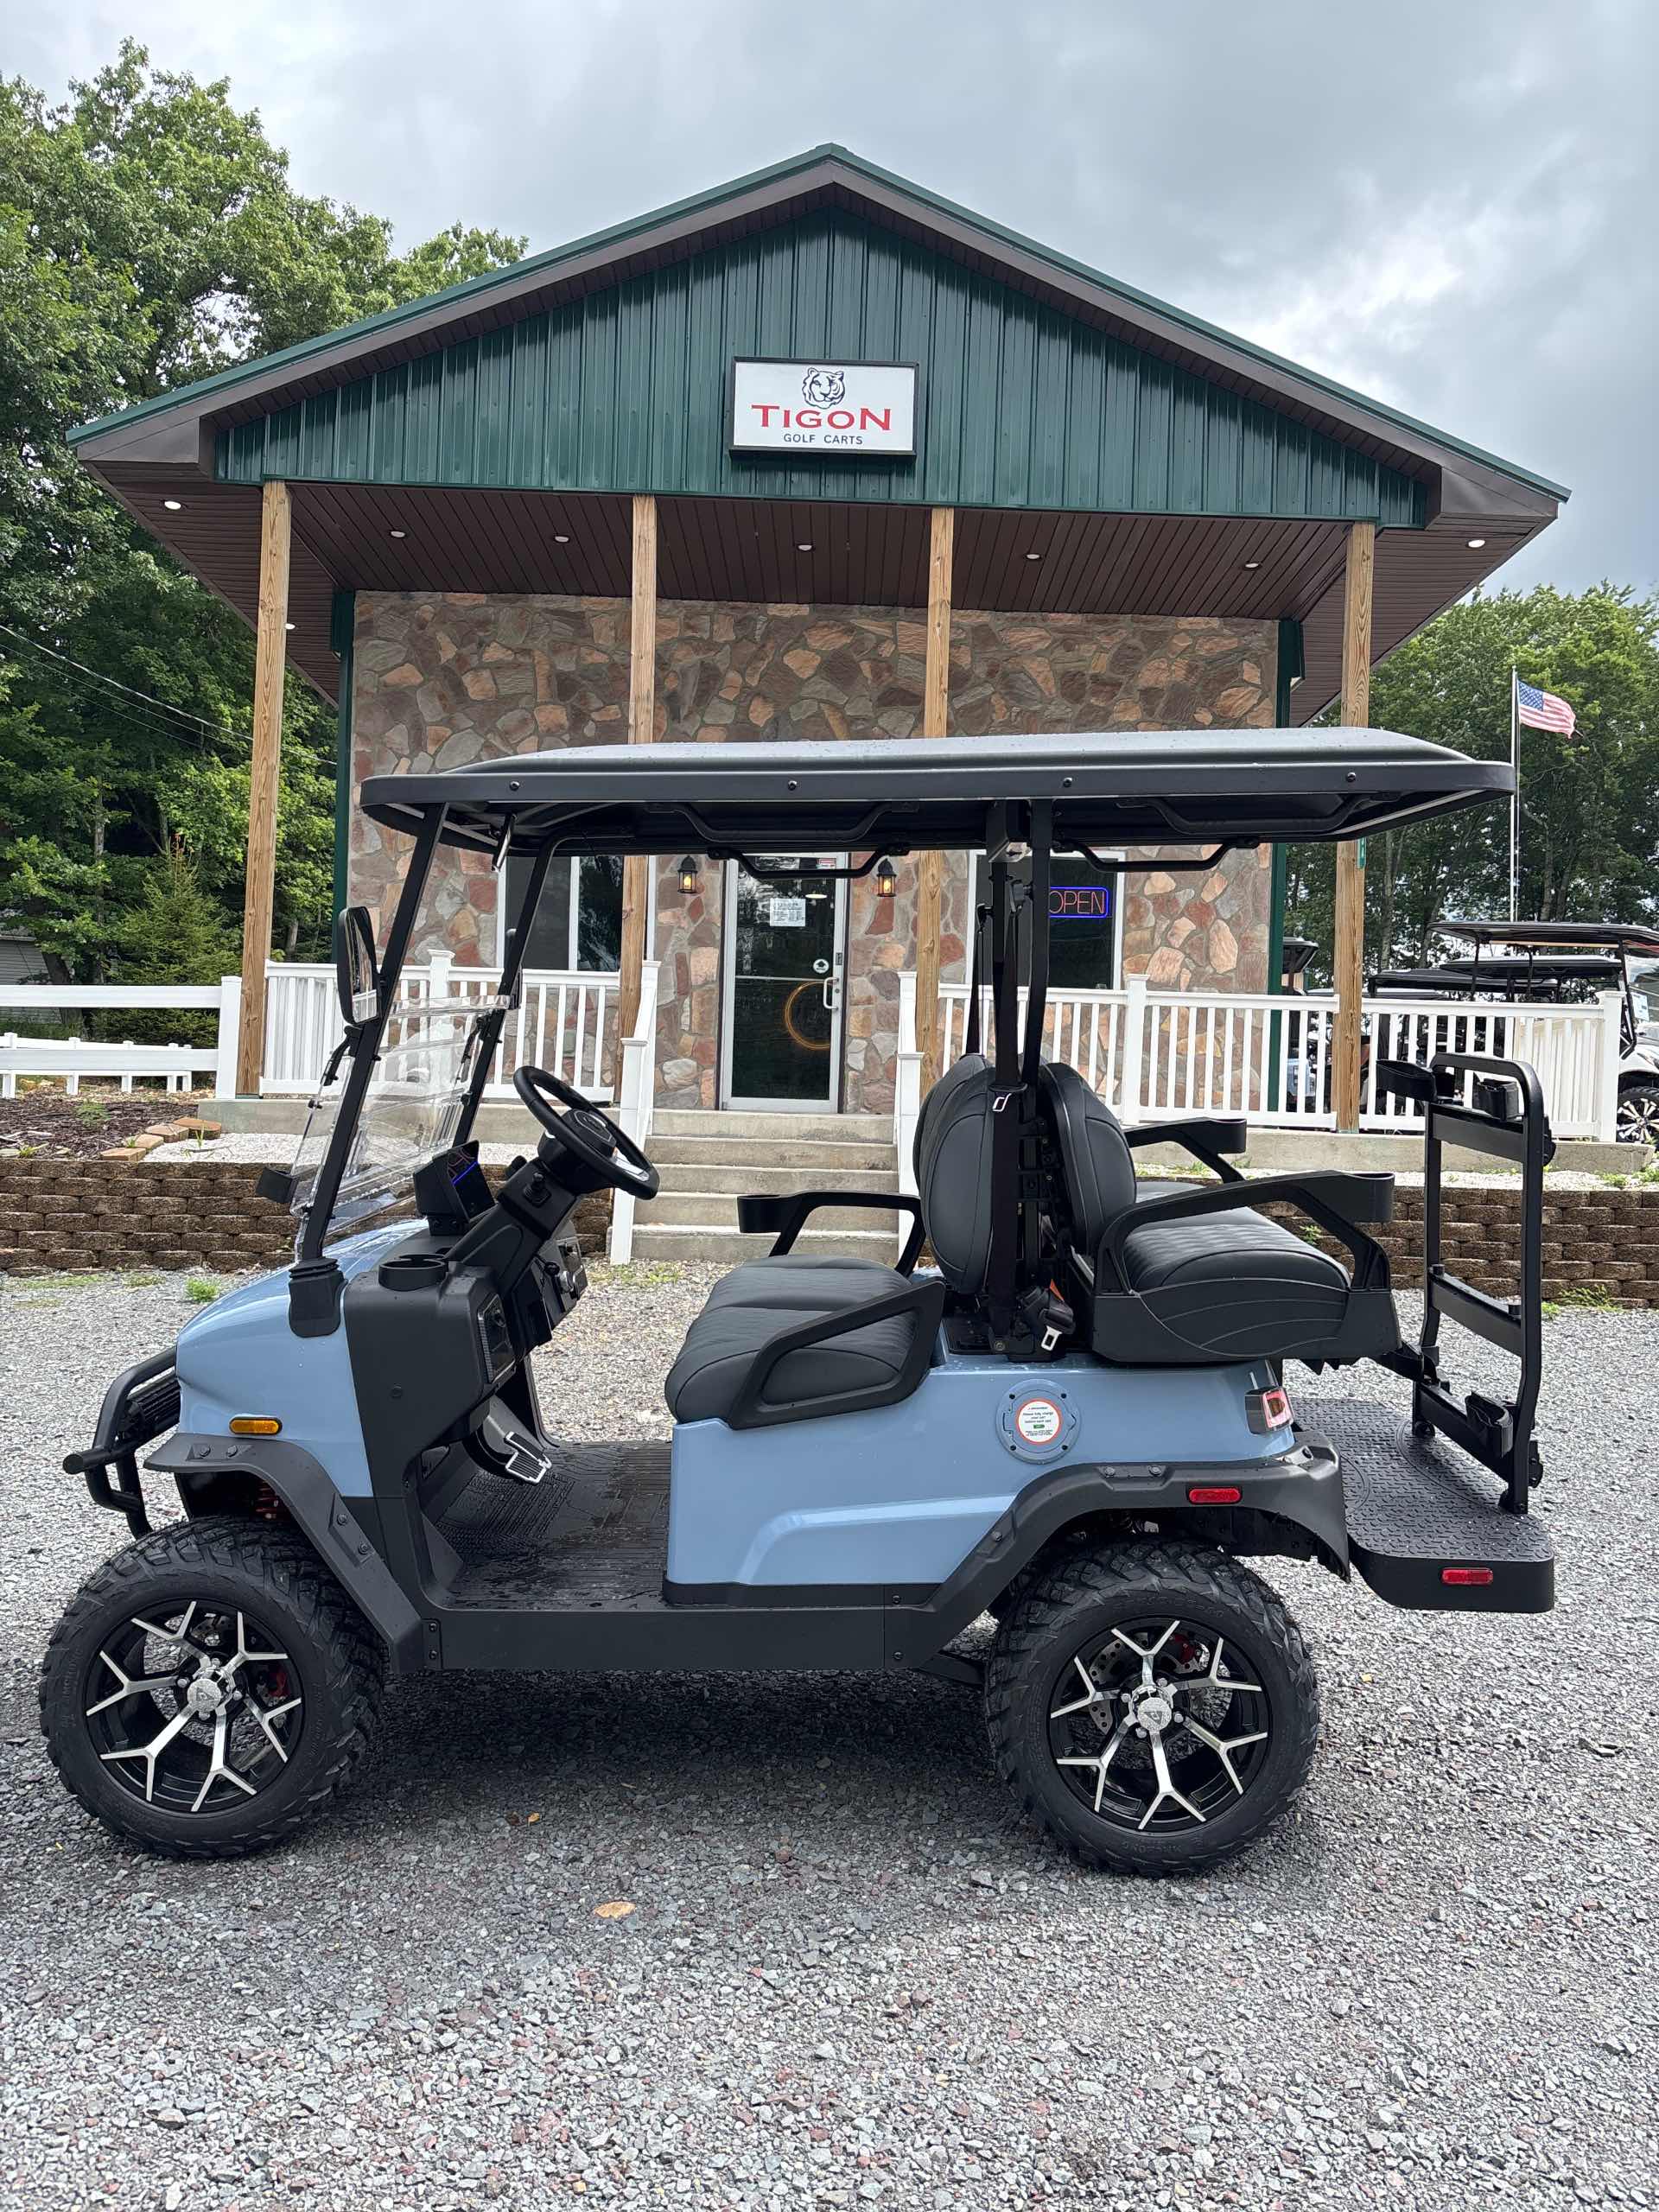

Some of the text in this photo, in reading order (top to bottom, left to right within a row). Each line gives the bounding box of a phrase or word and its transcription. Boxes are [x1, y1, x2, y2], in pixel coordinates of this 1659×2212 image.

[751, 404, 891, 431] TIGON
[783, 433, 863, 445] GOLF CARTS
[1049, 890, 1104, 914] OPEN
